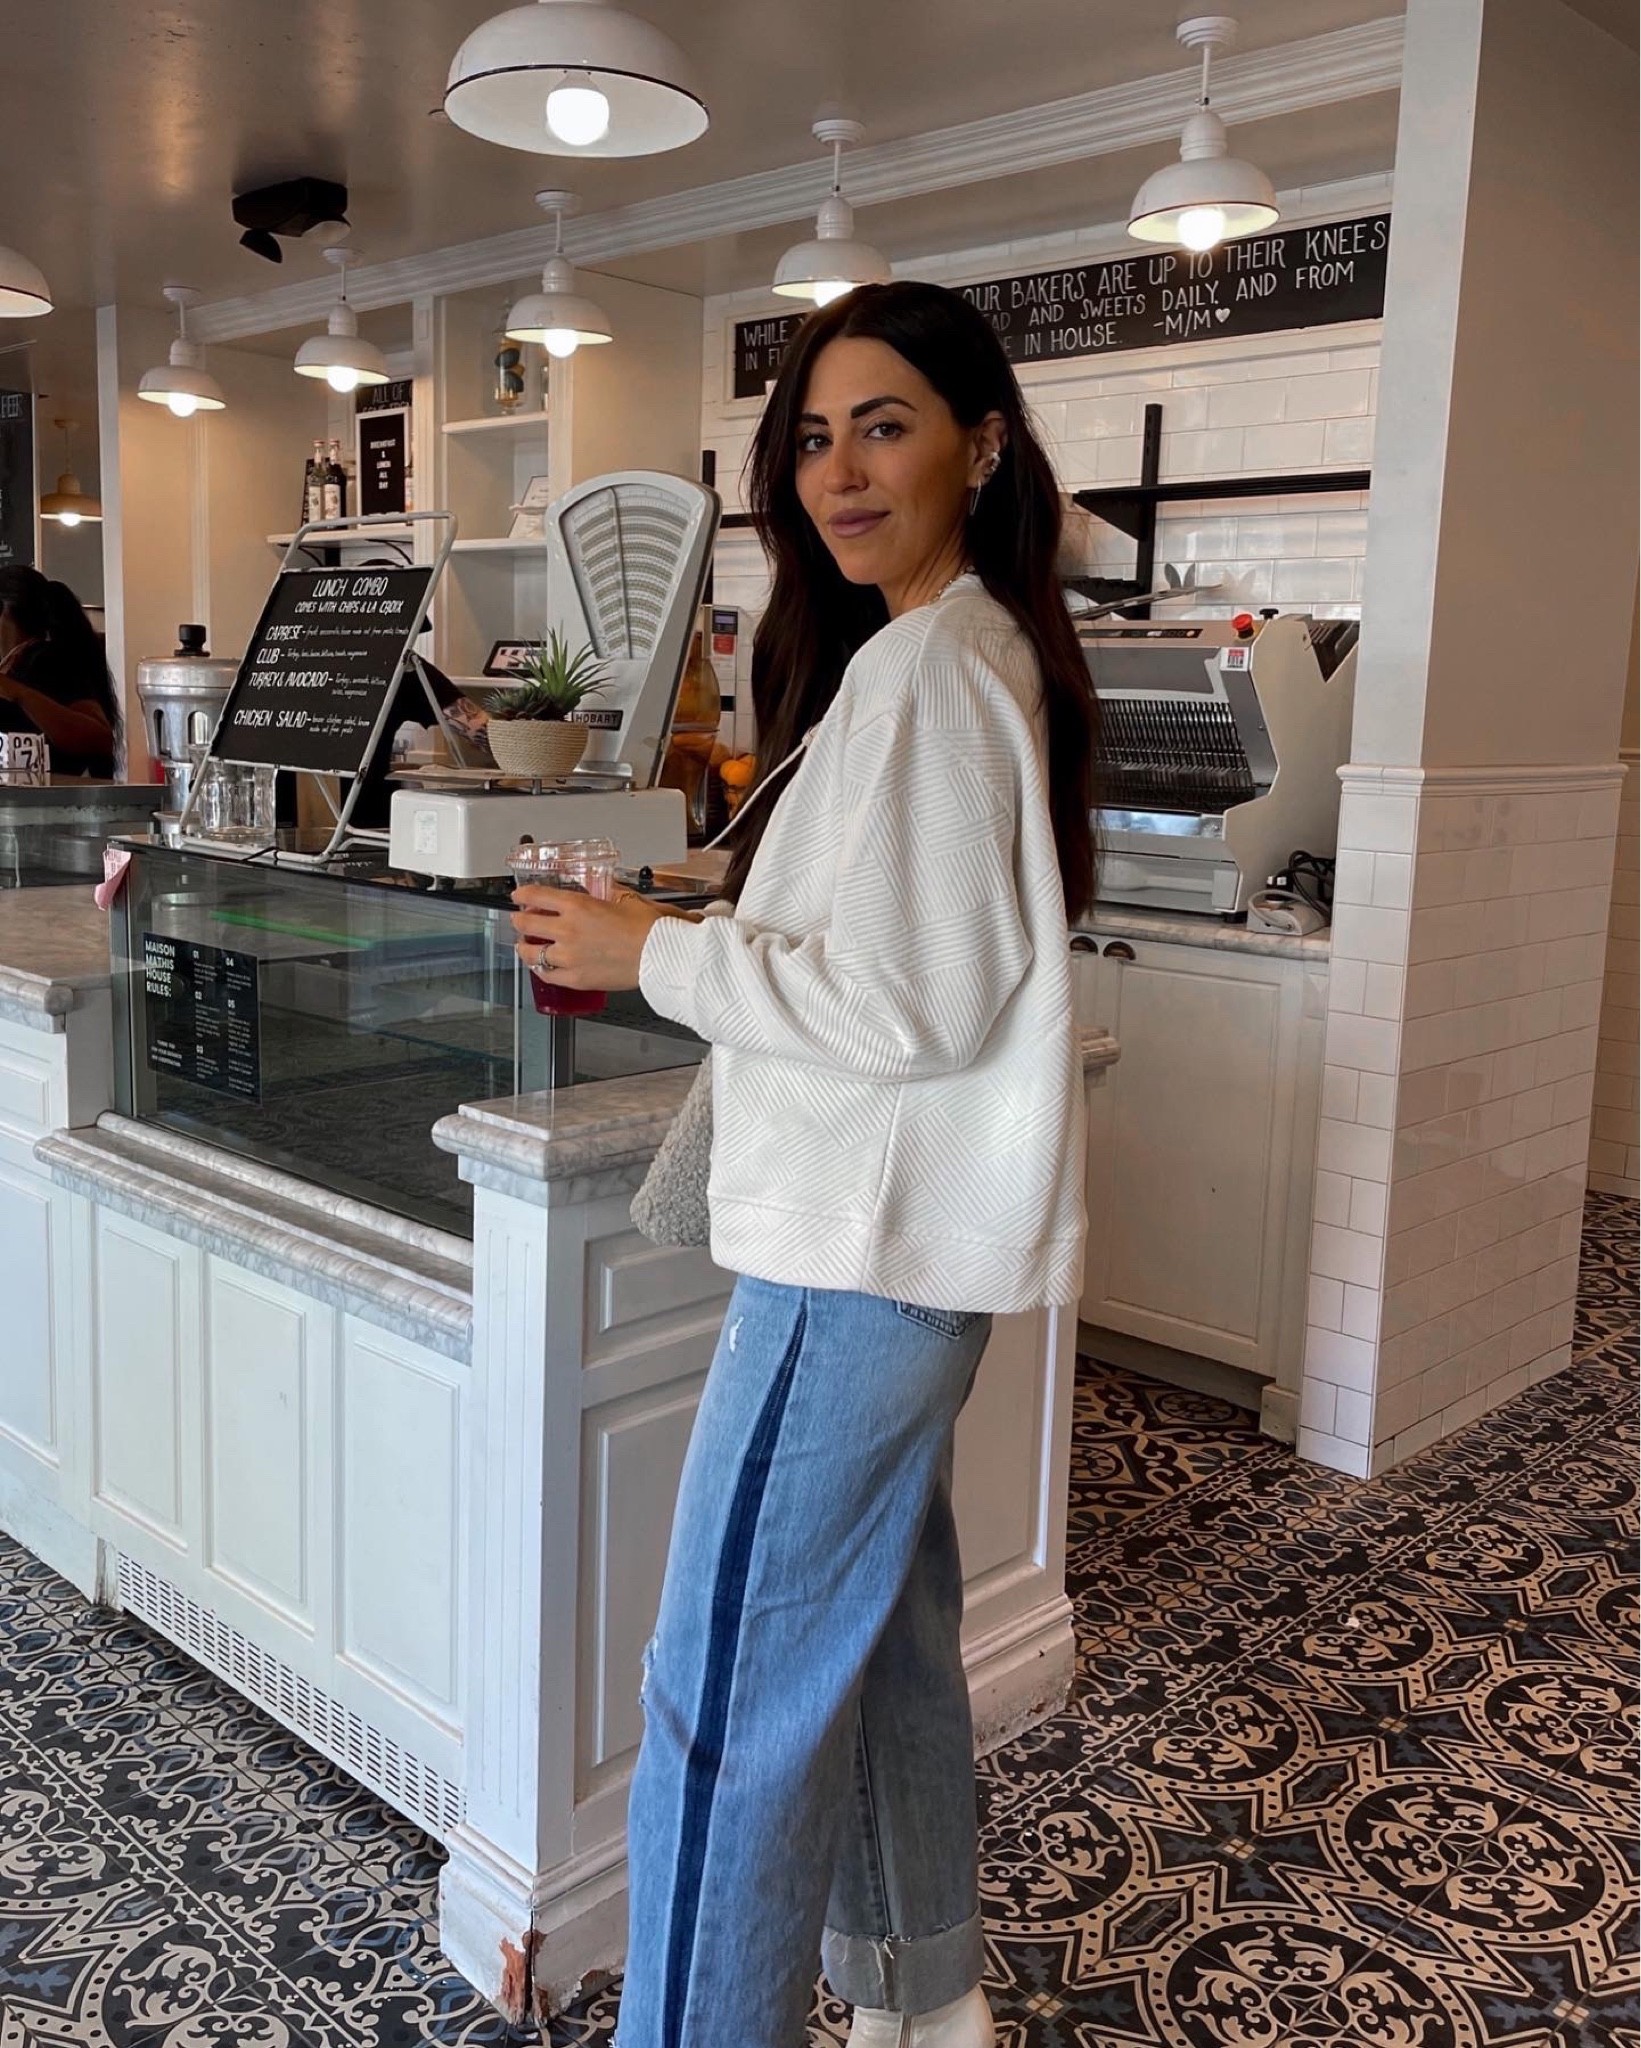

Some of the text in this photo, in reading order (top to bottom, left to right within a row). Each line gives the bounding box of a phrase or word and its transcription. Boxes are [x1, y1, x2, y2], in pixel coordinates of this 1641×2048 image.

[962, 220, 1387, 312] OUR BAKERS ARE UP TO THEIR KNEES
[1029, 304, 1065, 327] AND
[1080, 294, 1146, 320] SWEETS
[1236, 272, 1277, 301] AND
[1295, 260, 1355, 290] FROM
[743, 320, 788, 347] WHILE
[1025, 332, 1042, 356] IN
[1051, 321, 1123, 351] HOUSE.
[745, 351, 758, 372] IN
[312, 576, 389, 597] LUNCH COMBO
[294, 601, 318, 613] COMES
[318, 601, 338, 613] WITH
[338, 600, 361, 613] CHIPS
[366, 600, 378, 614] LA
[379, 600, 405, 616] CROIX
[234, 708, 274, 728] CHICKEN
[575, 712, 618, 724] HOBART
[145, 940, 175, 958] MAISON
[145, 954, 175, 971] MATHIS
[146, 967, 172, 985] HOUSE
[146, 981, 172, 998] RULES:
